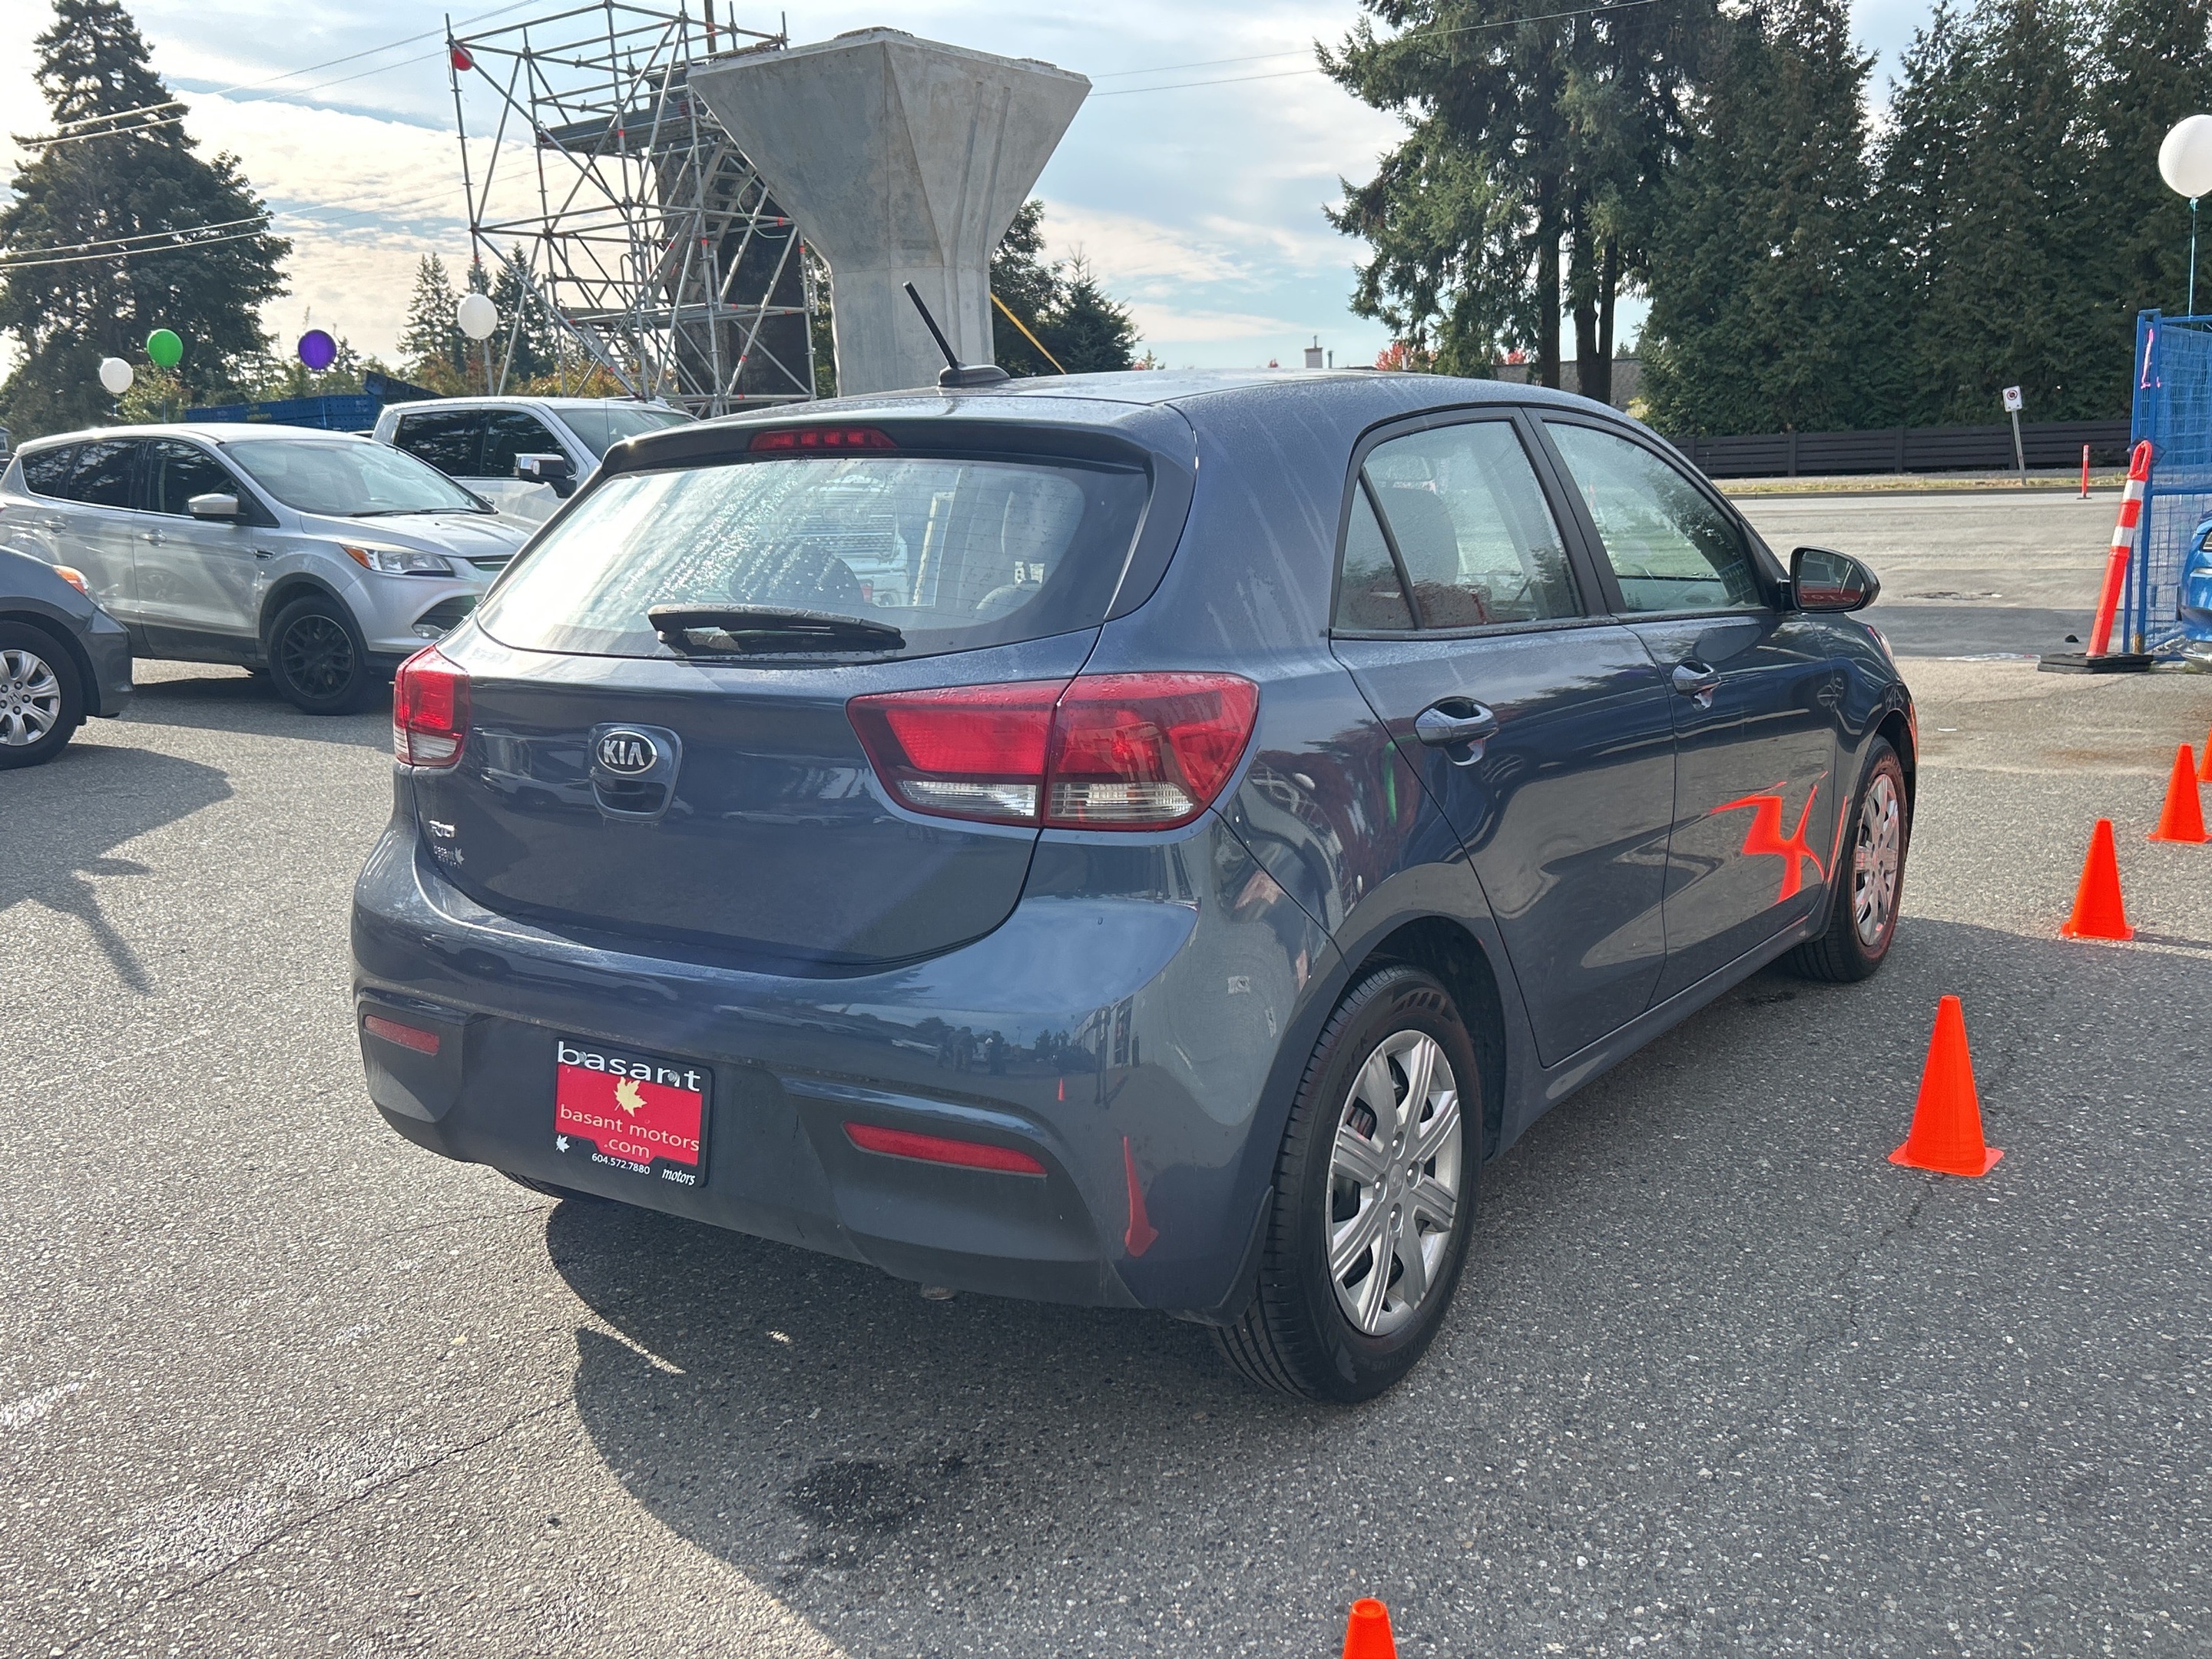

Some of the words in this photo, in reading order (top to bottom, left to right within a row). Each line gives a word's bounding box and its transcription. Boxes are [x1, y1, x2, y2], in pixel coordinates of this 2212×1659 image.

[604, 740, 645, 766] KIA
[558, 1041, 701, 1092] basant
[560, 1104, 623, 1133] basant
[629, 1124, 700, 1151] motors
[604, 1138, 650, 1158] .com
[591, 1153, 651, 1174] 604.572.7880
[661, 1168, 696, 1186] motors
